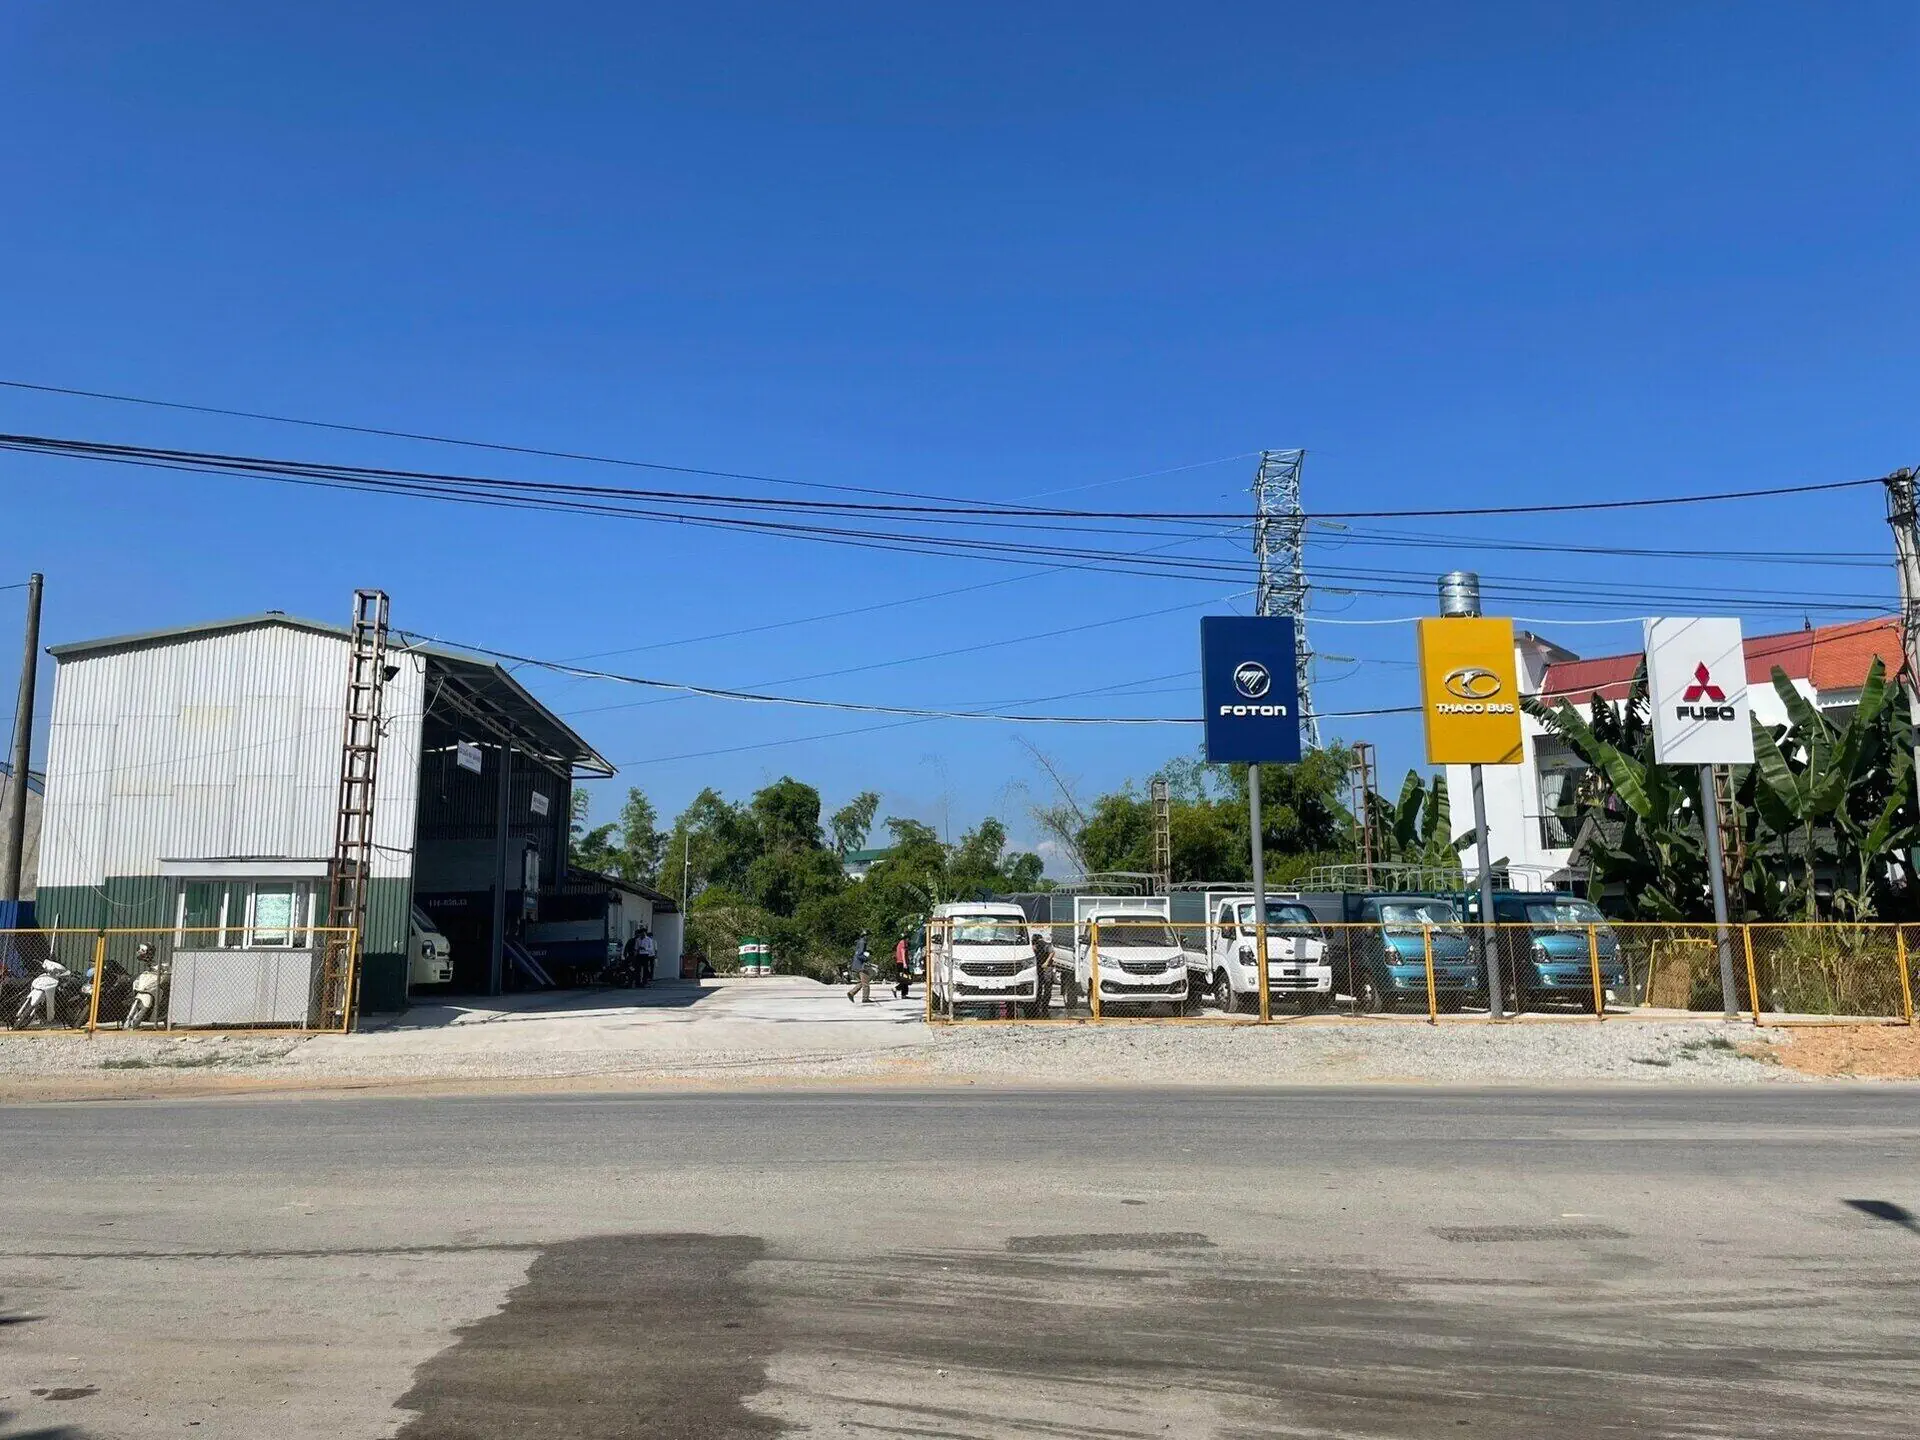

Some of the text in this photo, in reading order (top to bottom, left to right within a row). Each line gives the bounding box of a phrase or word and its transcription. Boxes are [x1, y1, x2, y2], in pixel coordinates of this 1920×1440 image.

[1220, 705, 1287, 716] FOTON
[1436, 703, 1515, 714] THACO BUS
[1676, 706, 1735, 721] FUSO
